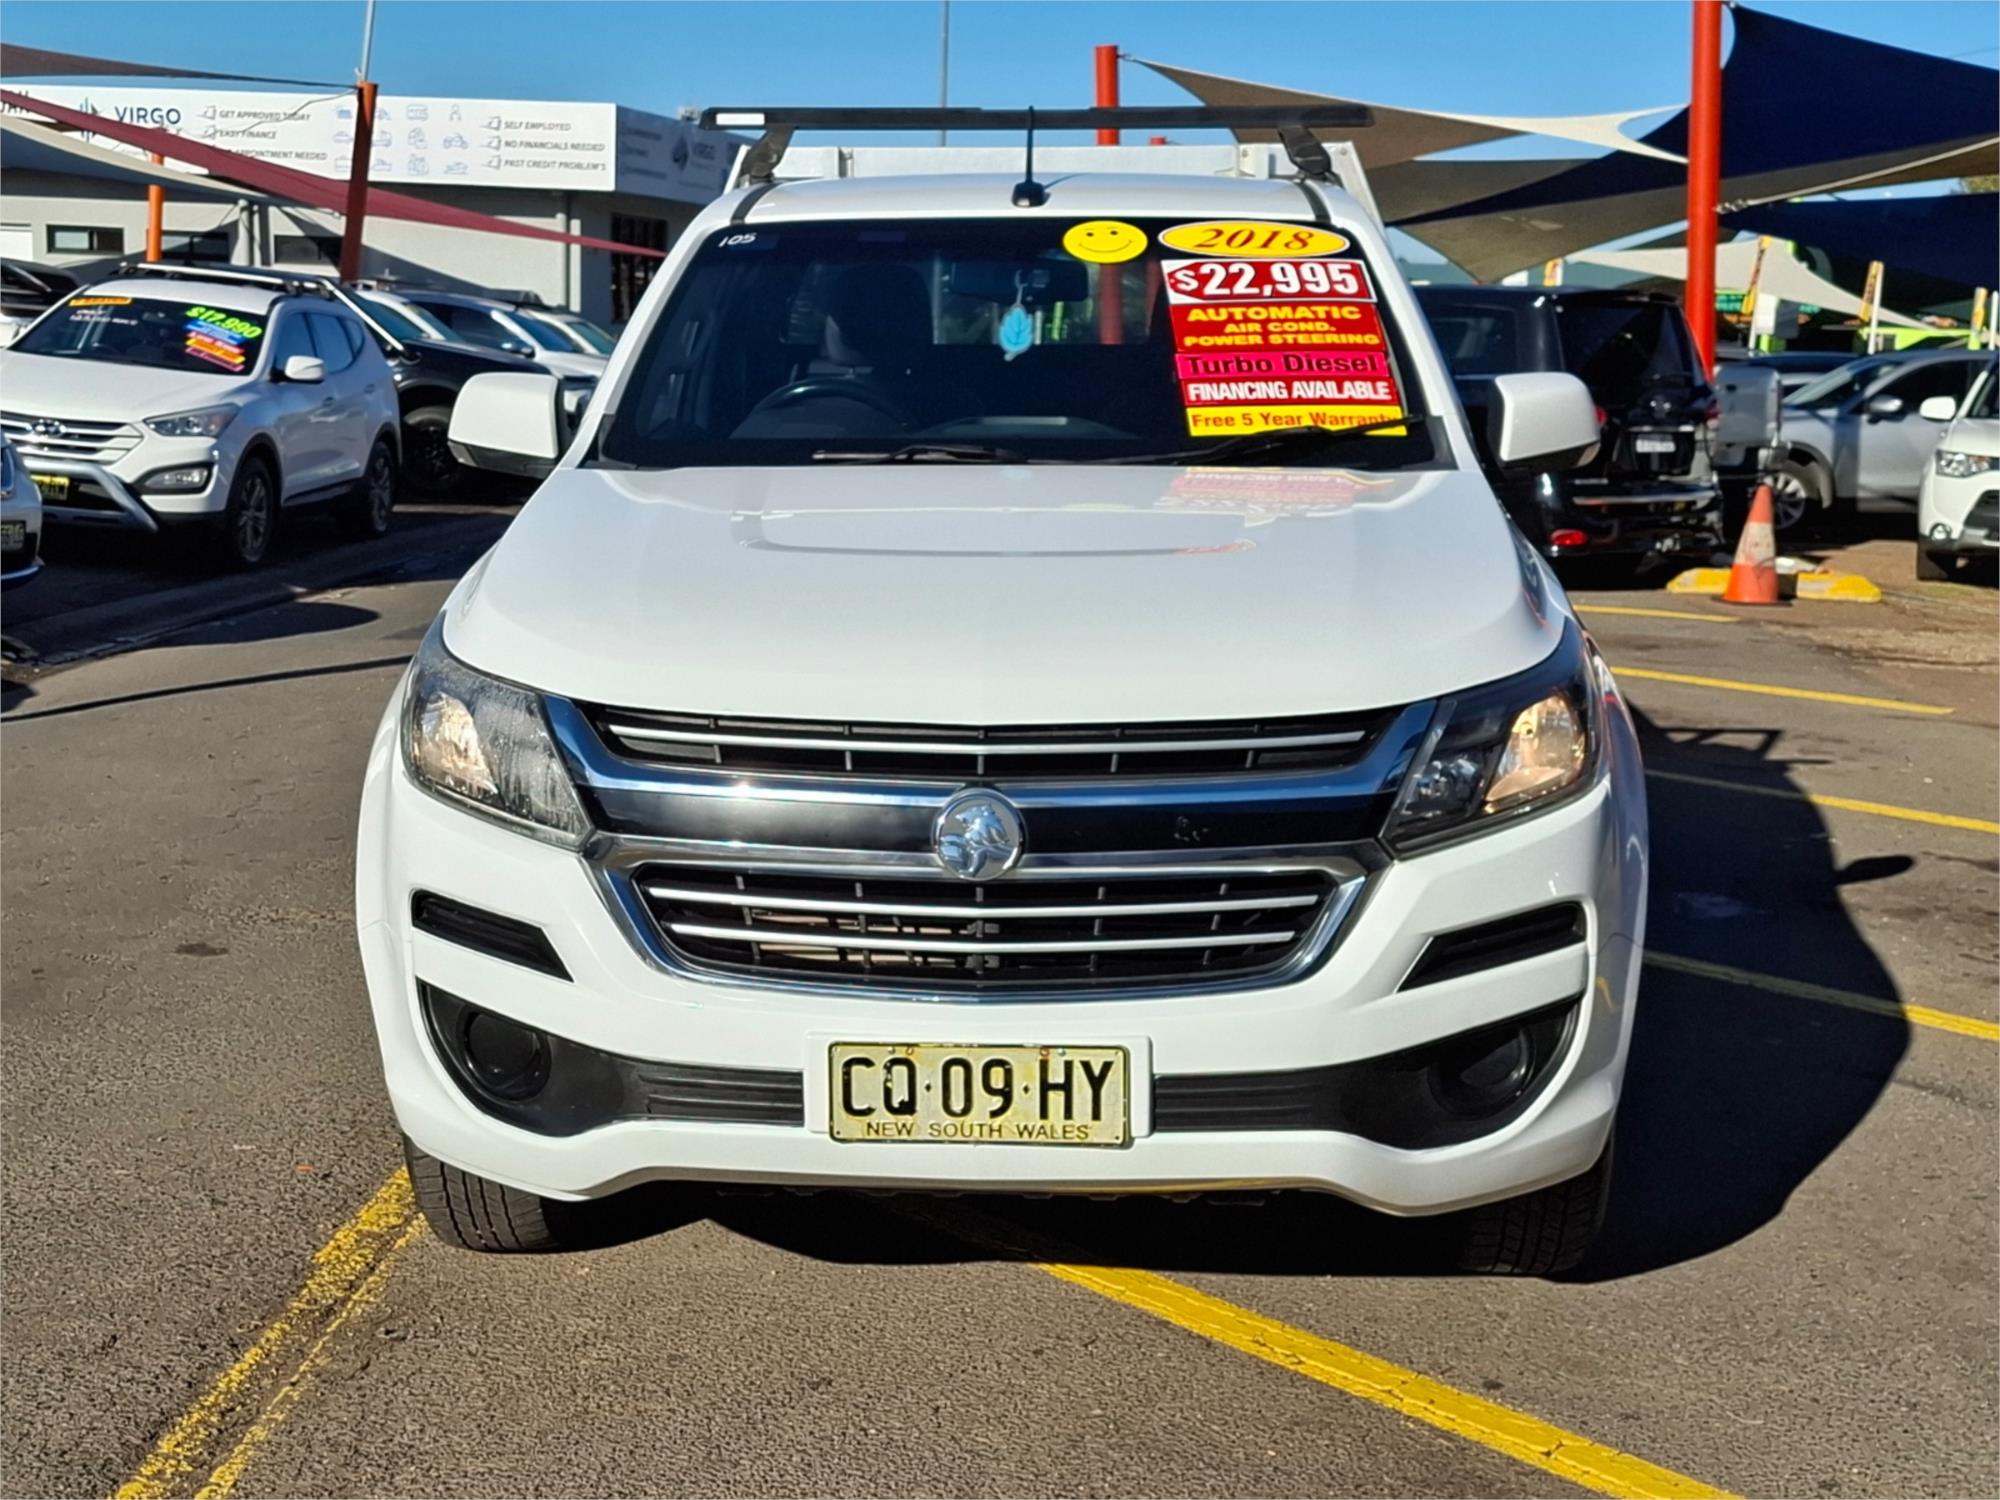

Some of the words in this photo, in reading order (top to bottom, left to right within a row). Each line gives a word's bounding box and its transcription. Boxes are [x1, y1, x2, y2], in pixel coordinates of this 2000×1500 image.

[114, 106, 182, 125] VIRGO
[219, 110, 236, 119] GET
[236, 110, 280, 121] APPROVED
[504, 121, 523, 130] SELF
[524, 121, 572, 131] EMPLOYED
[219, 129, 241, 138] EASY
[242, 129, 277, 139] FINANCE
[504, 140, 518, 148] NO
[519, 140, 568, 150] FINANCIALS
[570, 143, 606, 152] NEEDED
[294, 151, 328, 160] NEEDED
[503, 159, 525, 168] PAST
[526, 160, 556, 169] CREDIT
[718, 232, 757, 247] 105
[1194, 228, 1314, 250] 2018
[1175, 262, 1359, 296] $22,995
[1187, 306, 1362, 322] AUTOMATIC
[1224, 323, 1263, 333] AIR
[1267, 322, 1337, 332] COND.
[1183, 335, 1264, 346] POWER
[1268, 333, 1380, 345] STEERING
[1185, 356, 1274, 375] Turbo
[1282, 353, 1378, 373] Diesel
[1187, 381, 1288, 402] FINANCING
[1291, 381, 1393, 400] AVAILABLE
[1192, 413, 1236, 428] Free
[1241, 412, 1254, 426] 5
[1260, 411, 1303, 427] Year
[865, 1122, 915, 1138] NEW
[928, 1122, 1002, 1139] SOUTH
[1015, 1124, 1090, 1140] WALES
